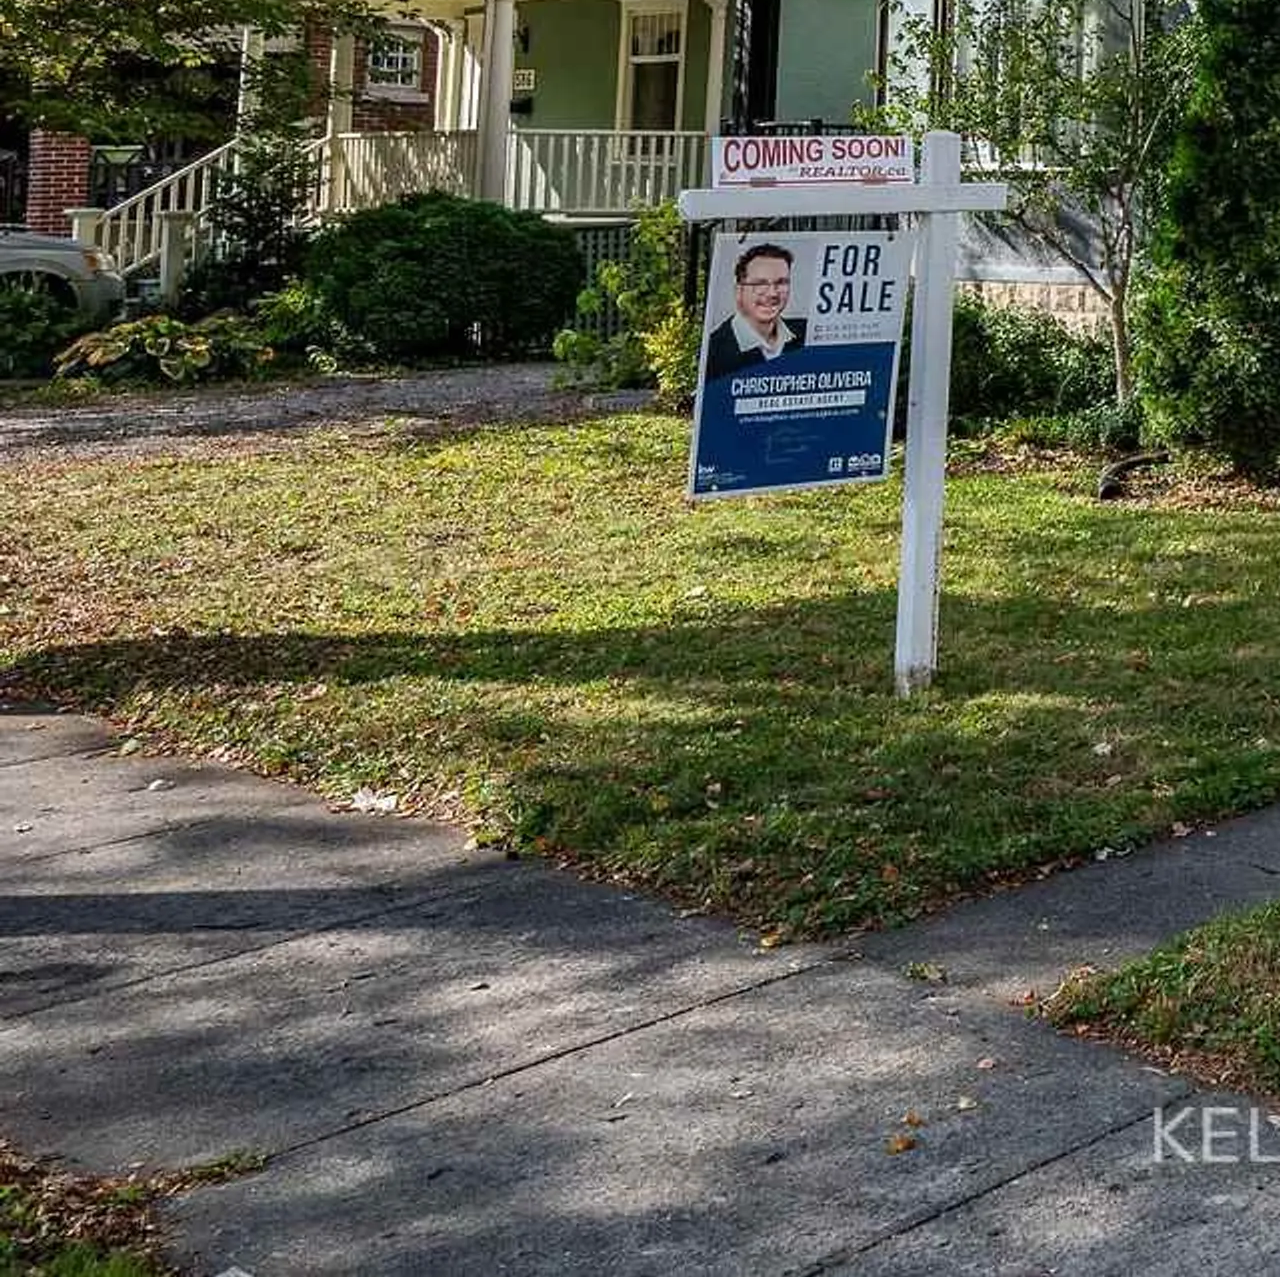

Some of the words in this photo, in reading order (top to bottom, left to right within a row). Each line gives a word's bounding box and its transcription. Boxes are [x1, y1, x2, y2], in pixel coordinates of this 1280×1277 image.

[724, 138, 823, 172] COMING
[831, 138, 905, 160] SOON!
[822, 244, 881, 276] FOR
[816, 280, 896, 315] SALE
[731, 373, 816, 397] CHRISTOPHER
[817, 370, 871, 390] OLIVEIRA
